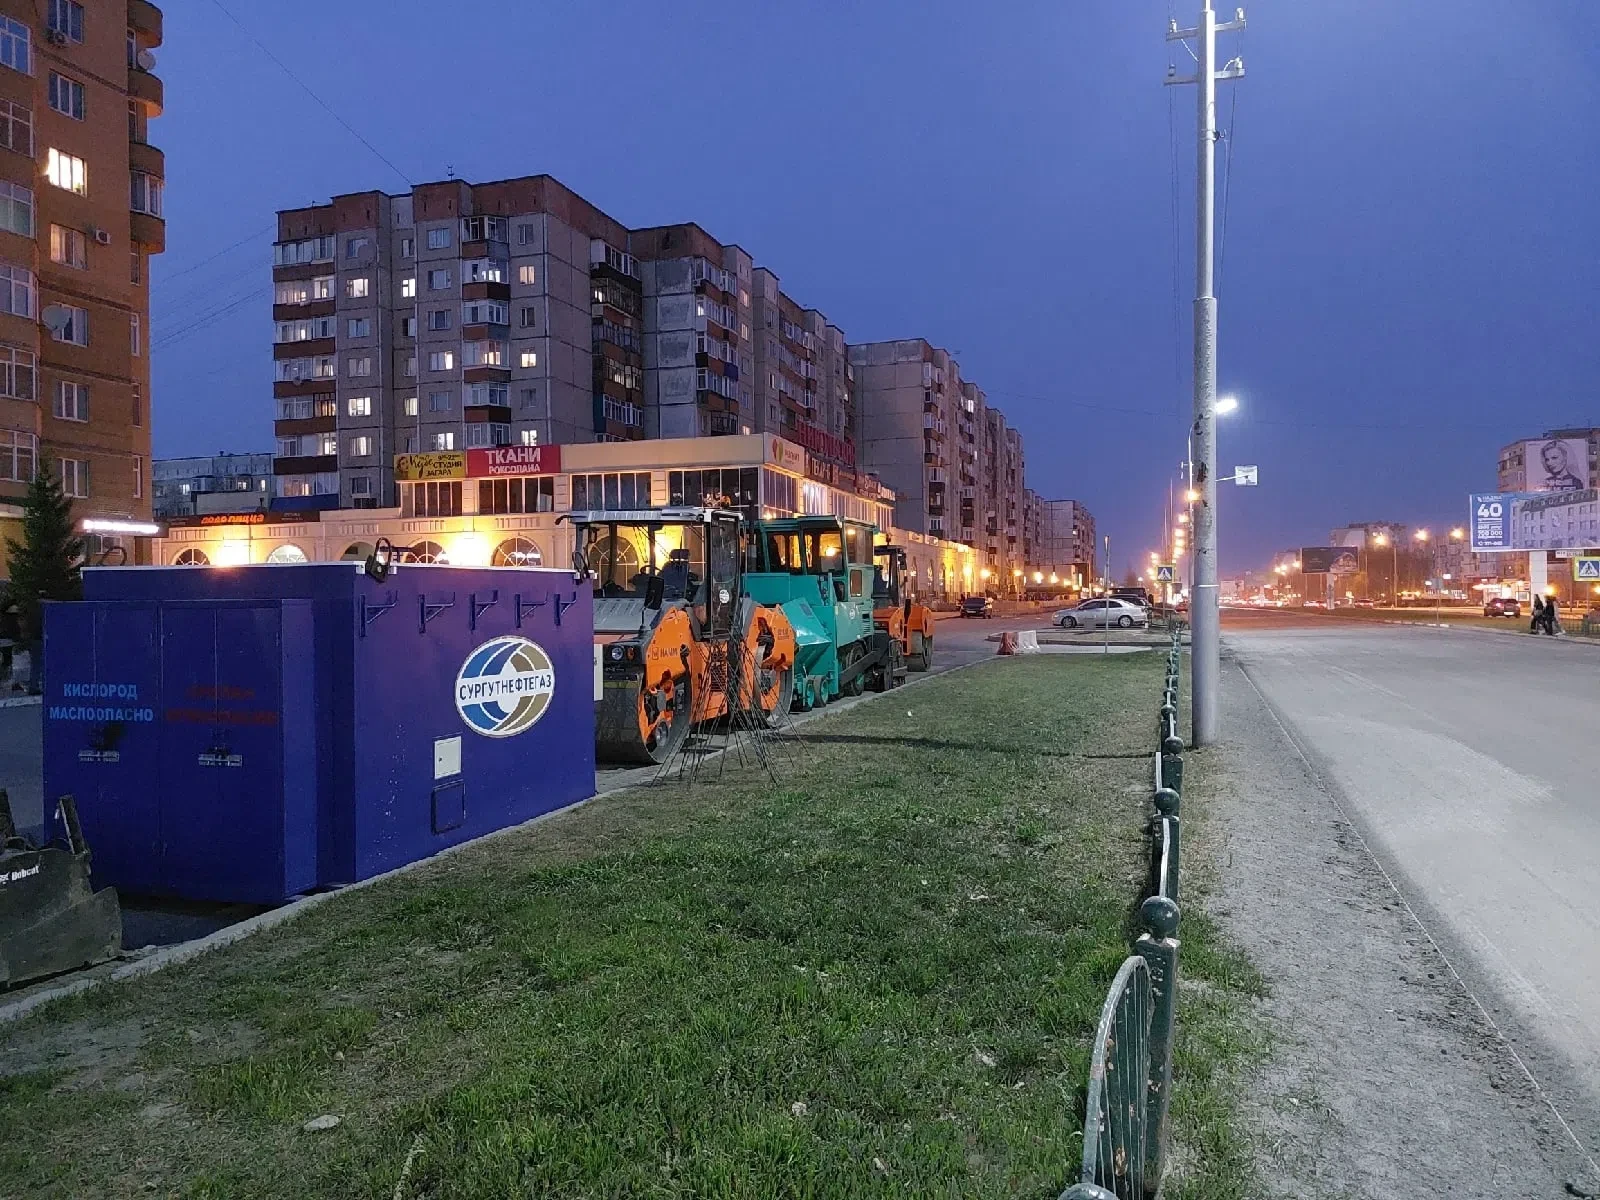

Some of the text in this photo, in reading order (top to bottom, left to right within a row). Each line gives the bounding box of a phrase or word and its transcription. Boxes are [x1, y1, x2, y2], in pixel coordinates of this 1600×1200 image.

[485, 447, 541, 465] ТКАНИ
[433, 461, 463, 469] СТУДИЯ
[489, 463, 541, 475] РОКСОЛАНА
[63, 683, 137, 700] КИСЛОРОД
[459, 674, 552, 701] СУРГУТНЕФТЕГАЗ
[49, 707, 154, 722] МАСЛООПАСНО
[11, 865, 40, 881] Bobcat
